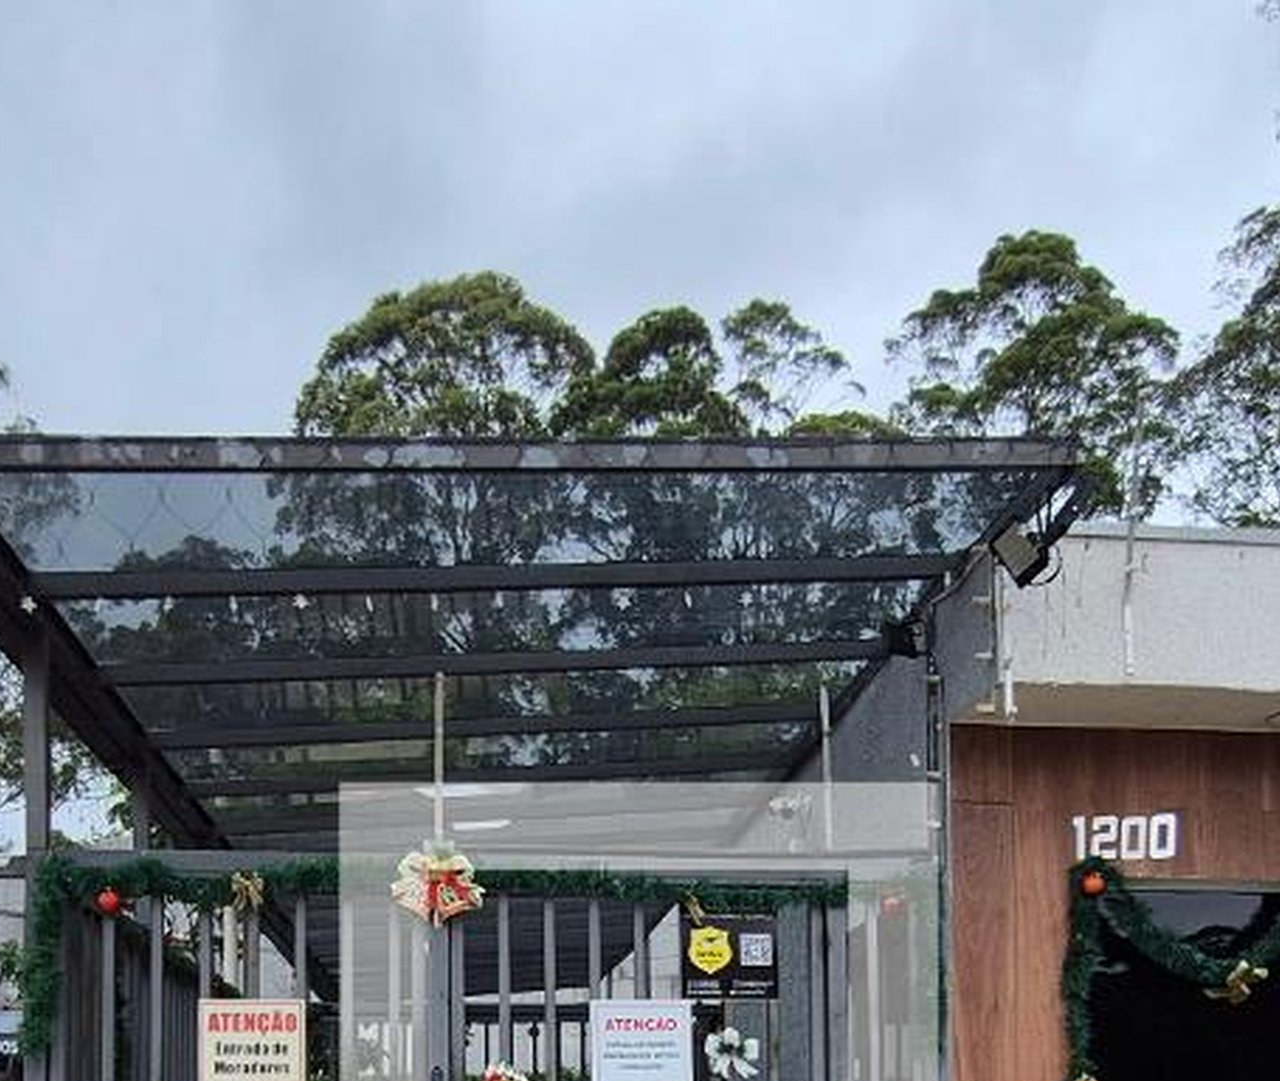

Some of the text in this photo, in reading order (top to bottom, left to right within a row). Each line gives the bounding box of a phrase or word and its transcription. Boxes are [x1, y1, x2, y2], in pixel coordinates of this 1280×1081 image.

[1072, 812, 1178, 860] 1200
[207, 1010, 298, 1036] ATENÇÃO
[215, 1041, 289, 1056] Entrada de
